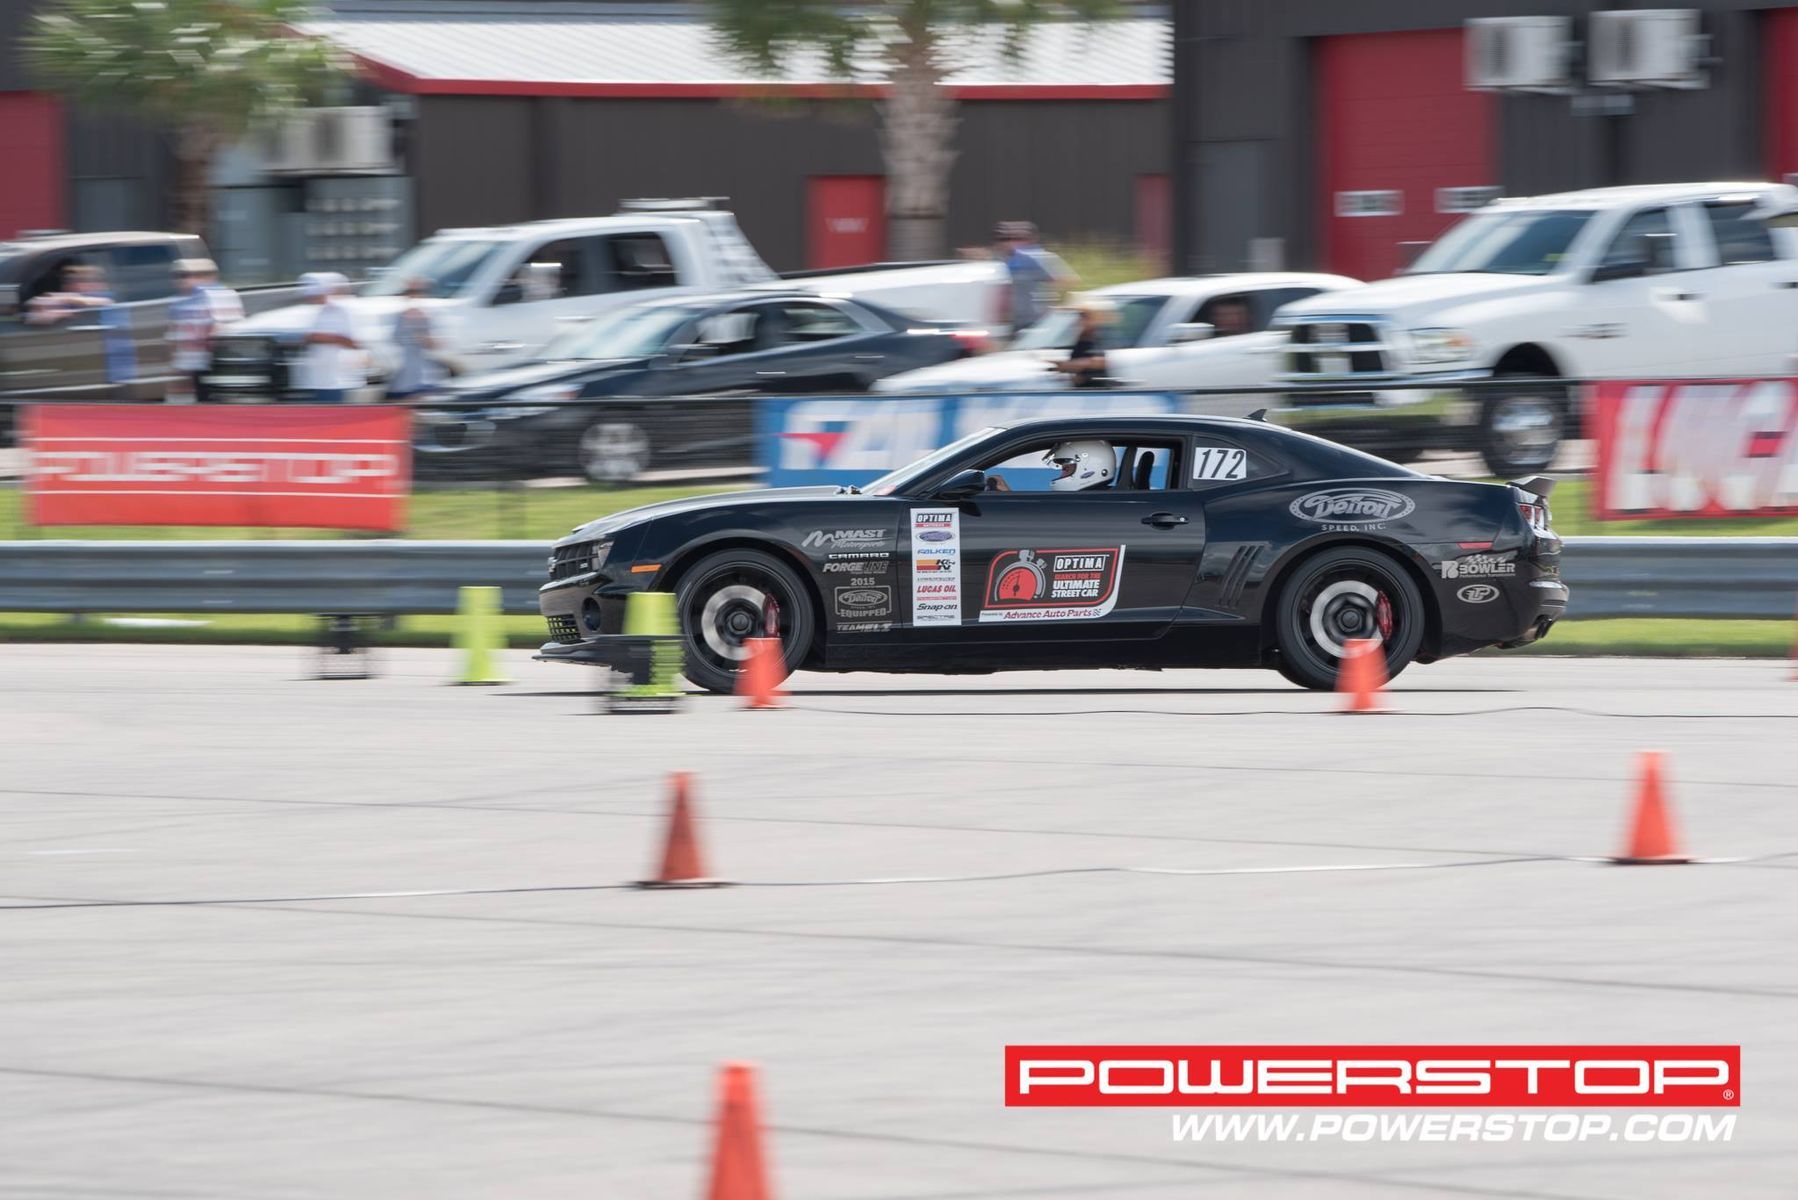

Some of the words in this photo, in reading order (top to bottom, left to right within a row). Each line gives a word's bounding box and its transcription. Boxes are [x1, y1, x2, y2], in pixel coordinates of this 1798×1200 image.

[1198, 450, 1245, 479] 172
[1303, 495, 1402, 520] Detroit
[917, 514, 952, 523] OPTIMA
[835, 529, 887, 538] MAST
[822, 560, 889, 573] FORGELINE
[1056, 557, 1102, 569] OPTIMA
[1459, 563, 1515, 574] BOWLER
[850, 578, 875, 586] 2015
[1053, 579, 1100, 589] ULTIMATE
[917, 585, 942, 593] LUCAS
[944, 585, 956, 593] OIL
[1051, 589, 1081, 598] STREET
[1081, 589, 1098, 597] CAR
[840, 607, 887, 618] EQUIPPED
[1003, 611, 1041, 619] Advance
[1042, 610, 1066, 618] Auto
[1067, 609, 1091, 617] Parts
